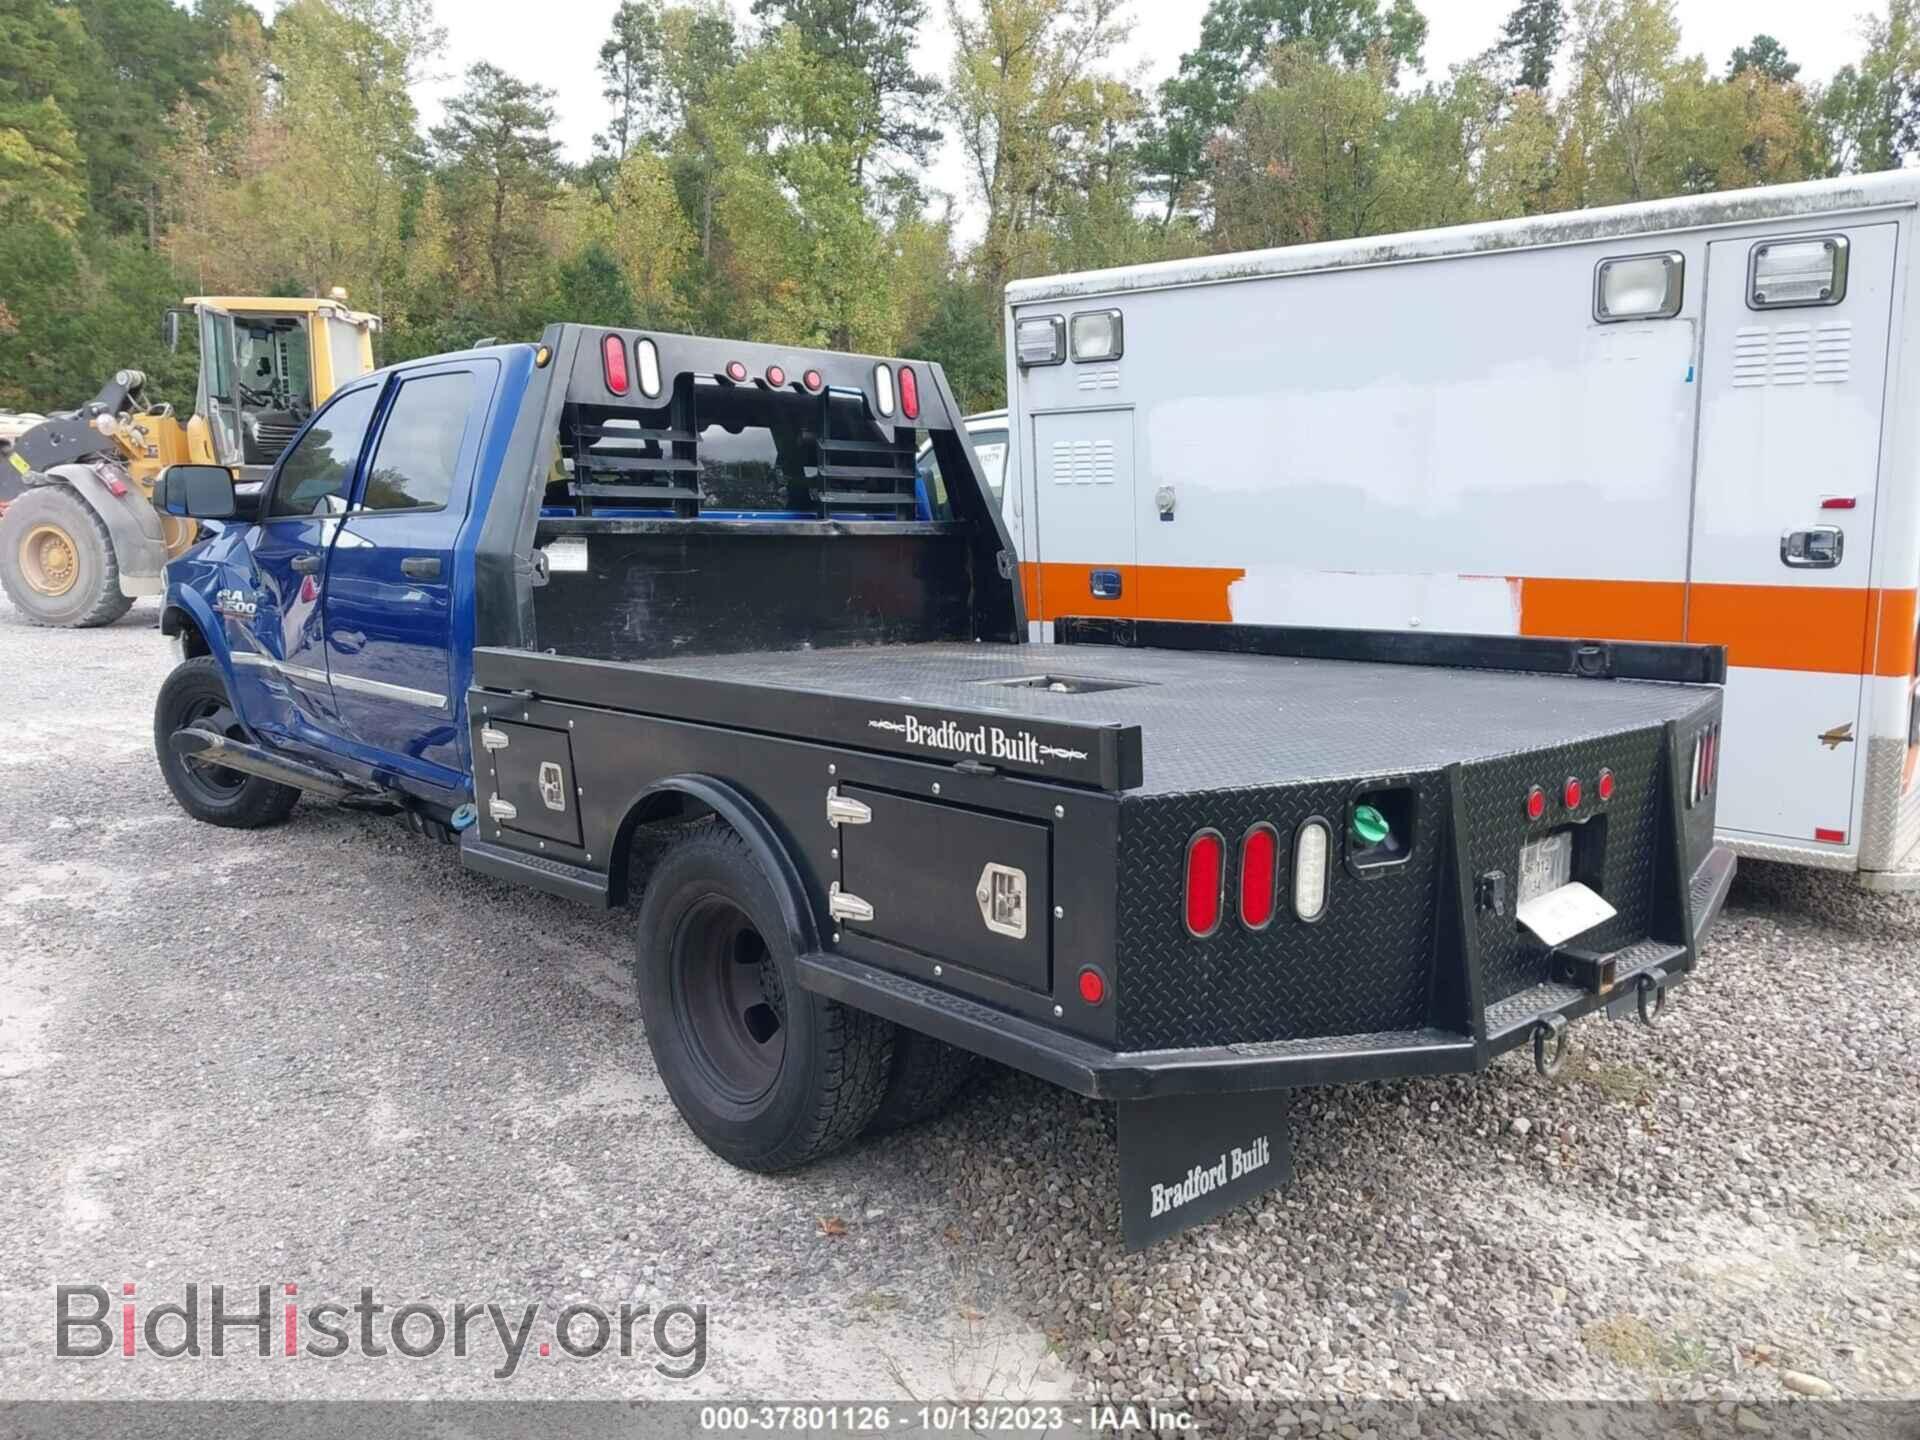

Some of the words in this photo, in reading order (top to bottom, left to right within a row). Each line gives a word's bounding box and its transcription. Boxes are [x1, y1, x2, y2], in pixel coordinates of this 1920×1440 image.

[904, 714, 986, 755] Bradford
[1150, 1154, 1228, 1218] Bradford
[1231, 1135, 1270, 1180] Built
